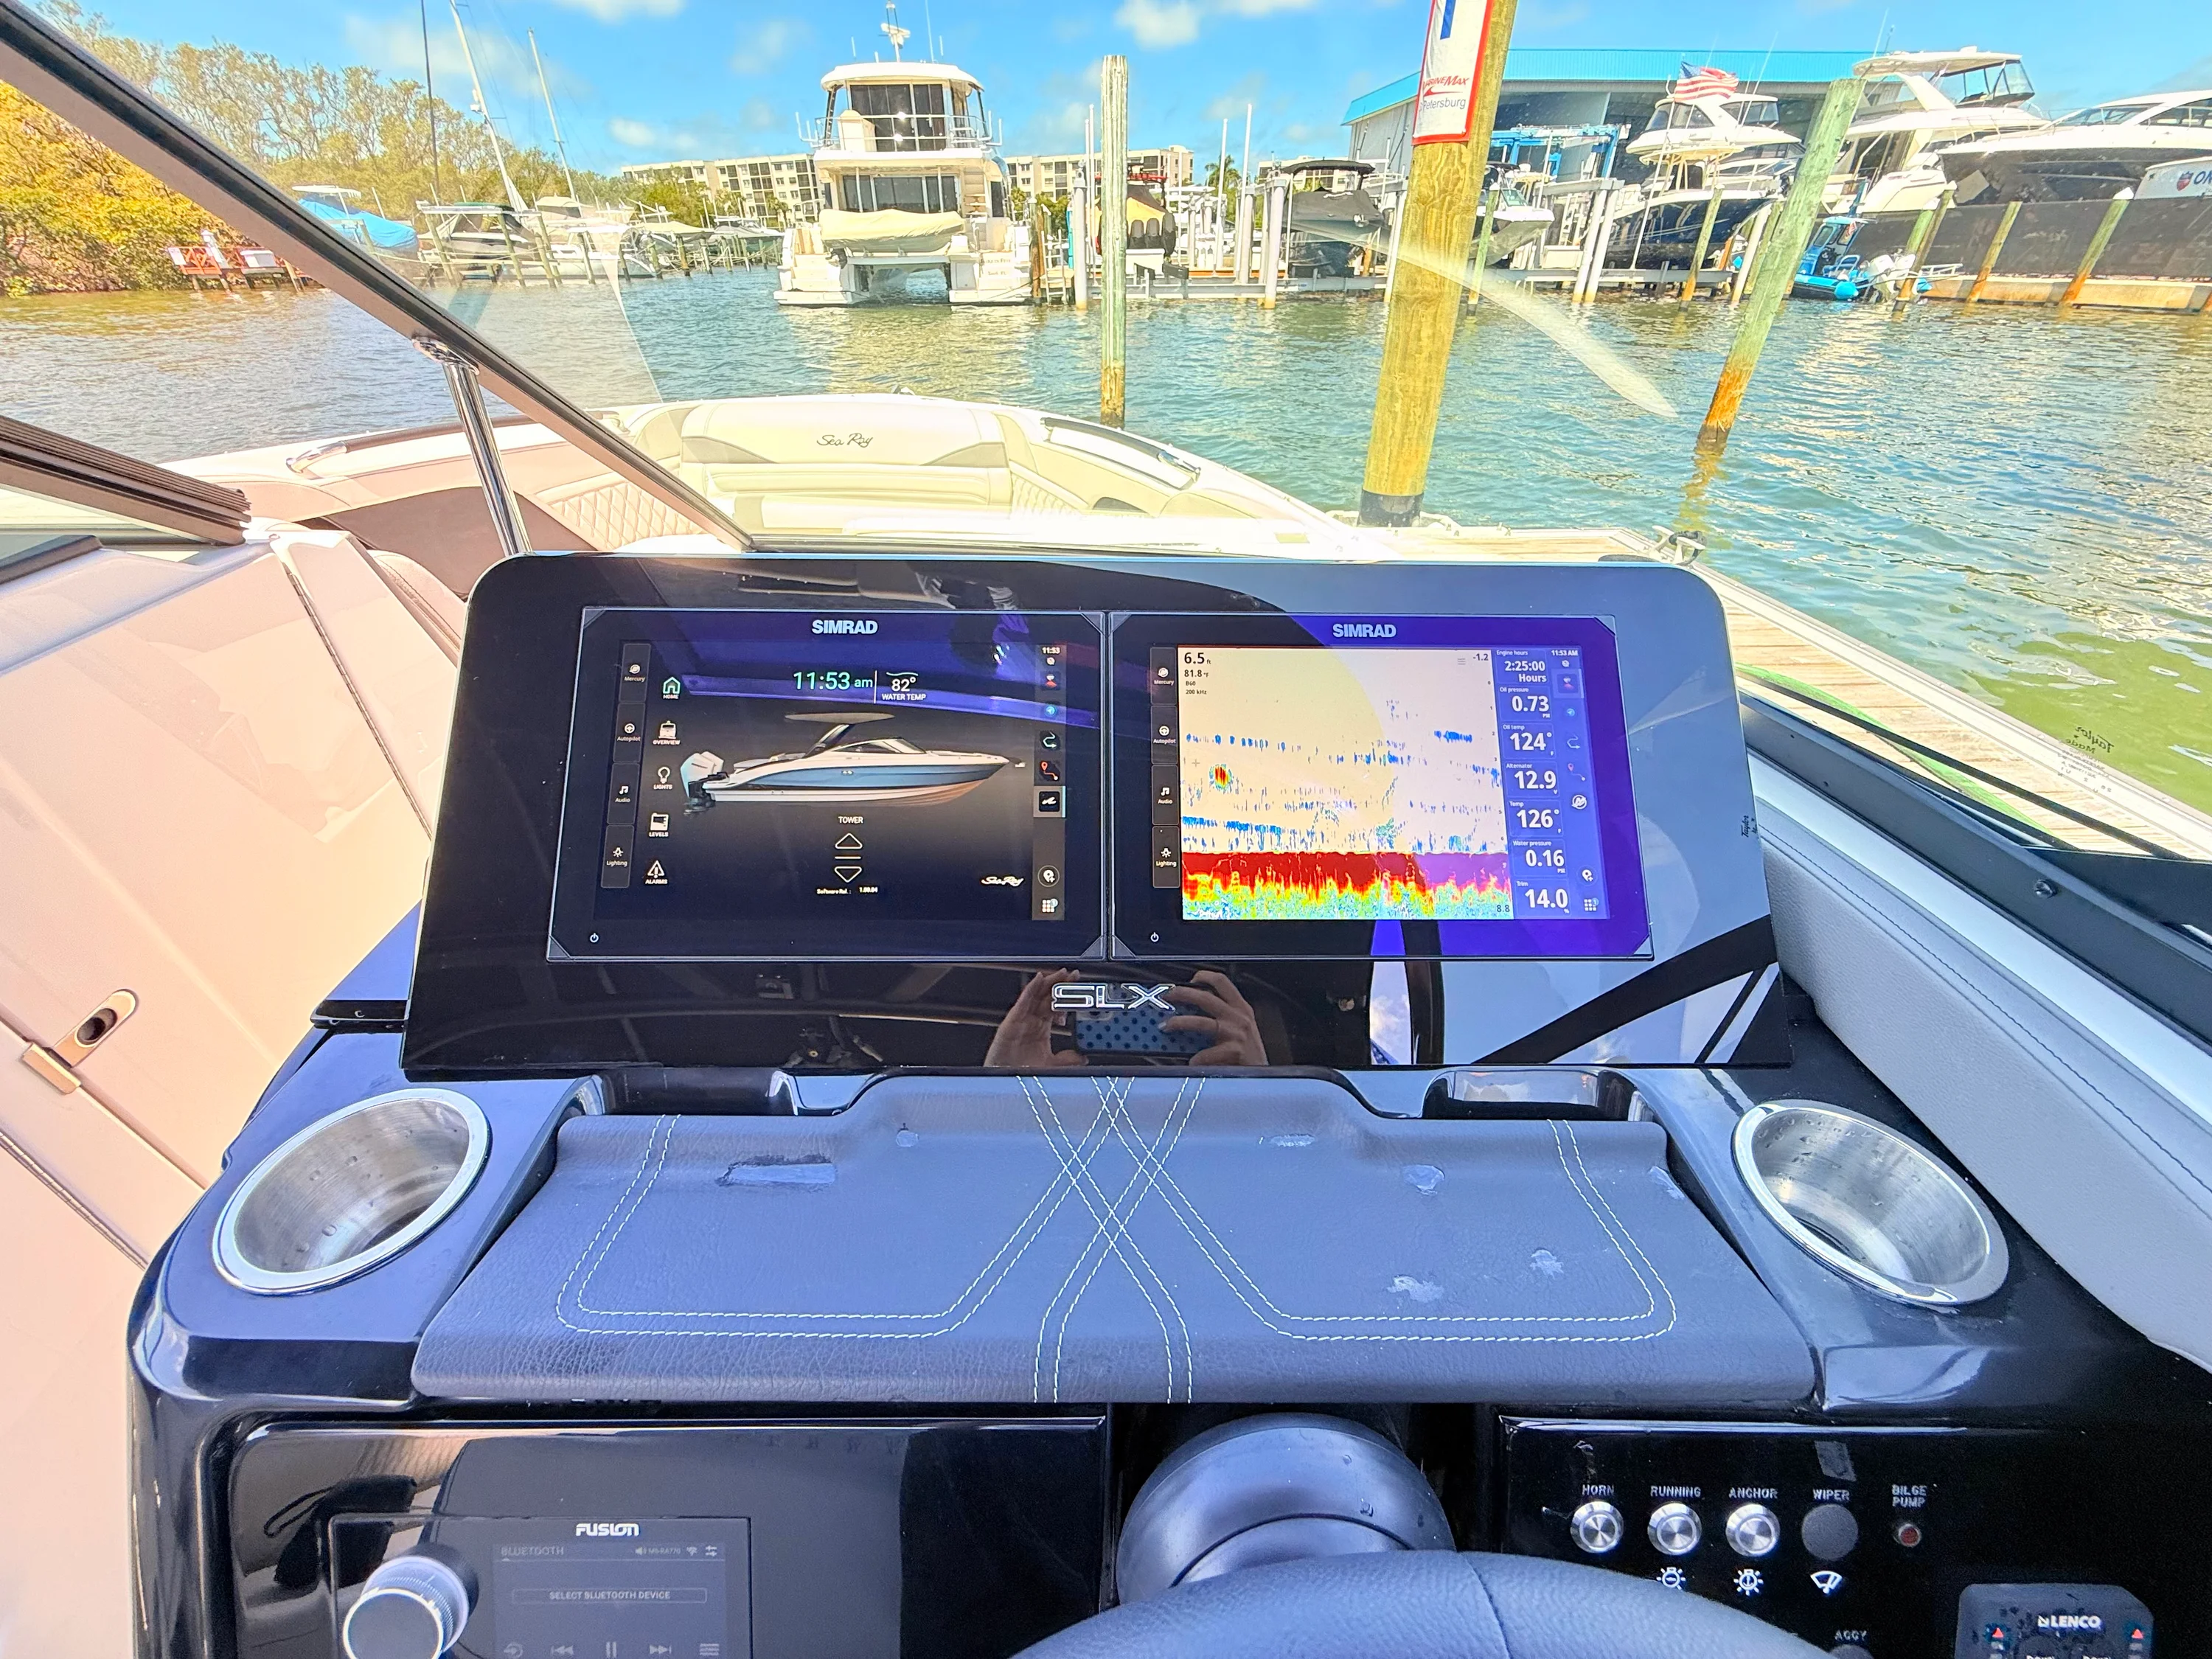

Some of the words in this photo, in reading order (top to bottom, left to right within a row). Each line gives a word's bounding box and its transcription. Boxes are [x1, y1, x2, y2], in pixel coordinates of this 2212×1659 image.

[816, 434, 845, 446] Sea
[846, 432, 874, 448] Ray
[812, 620, 878, 635] SIMRAD
[1332, 624, 1397, 638] SIMRAD
[1184, 652, 1205, 664] 6.5
[1472, 653, 1489, 661] -1.2
[1504, 660, 1546, 672] 2:25:00
[1184, 669, 1203, 678] 81.8
[1518, 673, 1547, 683] Hours
[793, 672, 851, 690] 11:53
[854, 679, 873, 688] am
[891, 676, 917, 692] 82°
[906, 693, 927, 701] TEMP
[1512, 695, 1550, 712] 0.73
[1514, 770, 1557, 789] 12.9
[838, 816, 864, 824] TOWER
[1525, 849, 1565, 867] 0.16
[1524, 888, 1568, 908] 14.0
[1497, 904, 1510, 913] 8.8
[1051, 982, 1176, 1012] SLX
[1582, 1484, 1615, 1496] HORN
[1649, 1485, 1702, 1498] RUNNING
[1728, 1487, 1778, 1500] ANCHOR
[1812, 1488, 1851, 1501] WIPER
[1891, 1484, 1927, 1497] BILGE
[1891, 1497, 1926, 1509] PUMP
[575, 1523, 640, 1537] FUSION
[501, 1546, 565, 1556] BLUETOOTH
[549, 1590, 583, 1600] SELECT
[583, 1590, 636, 1600] BLUETOOTH
[638, 1590, 671, 1600] DEVICE
[2051, 1615, 2101, 1629] LENCO
